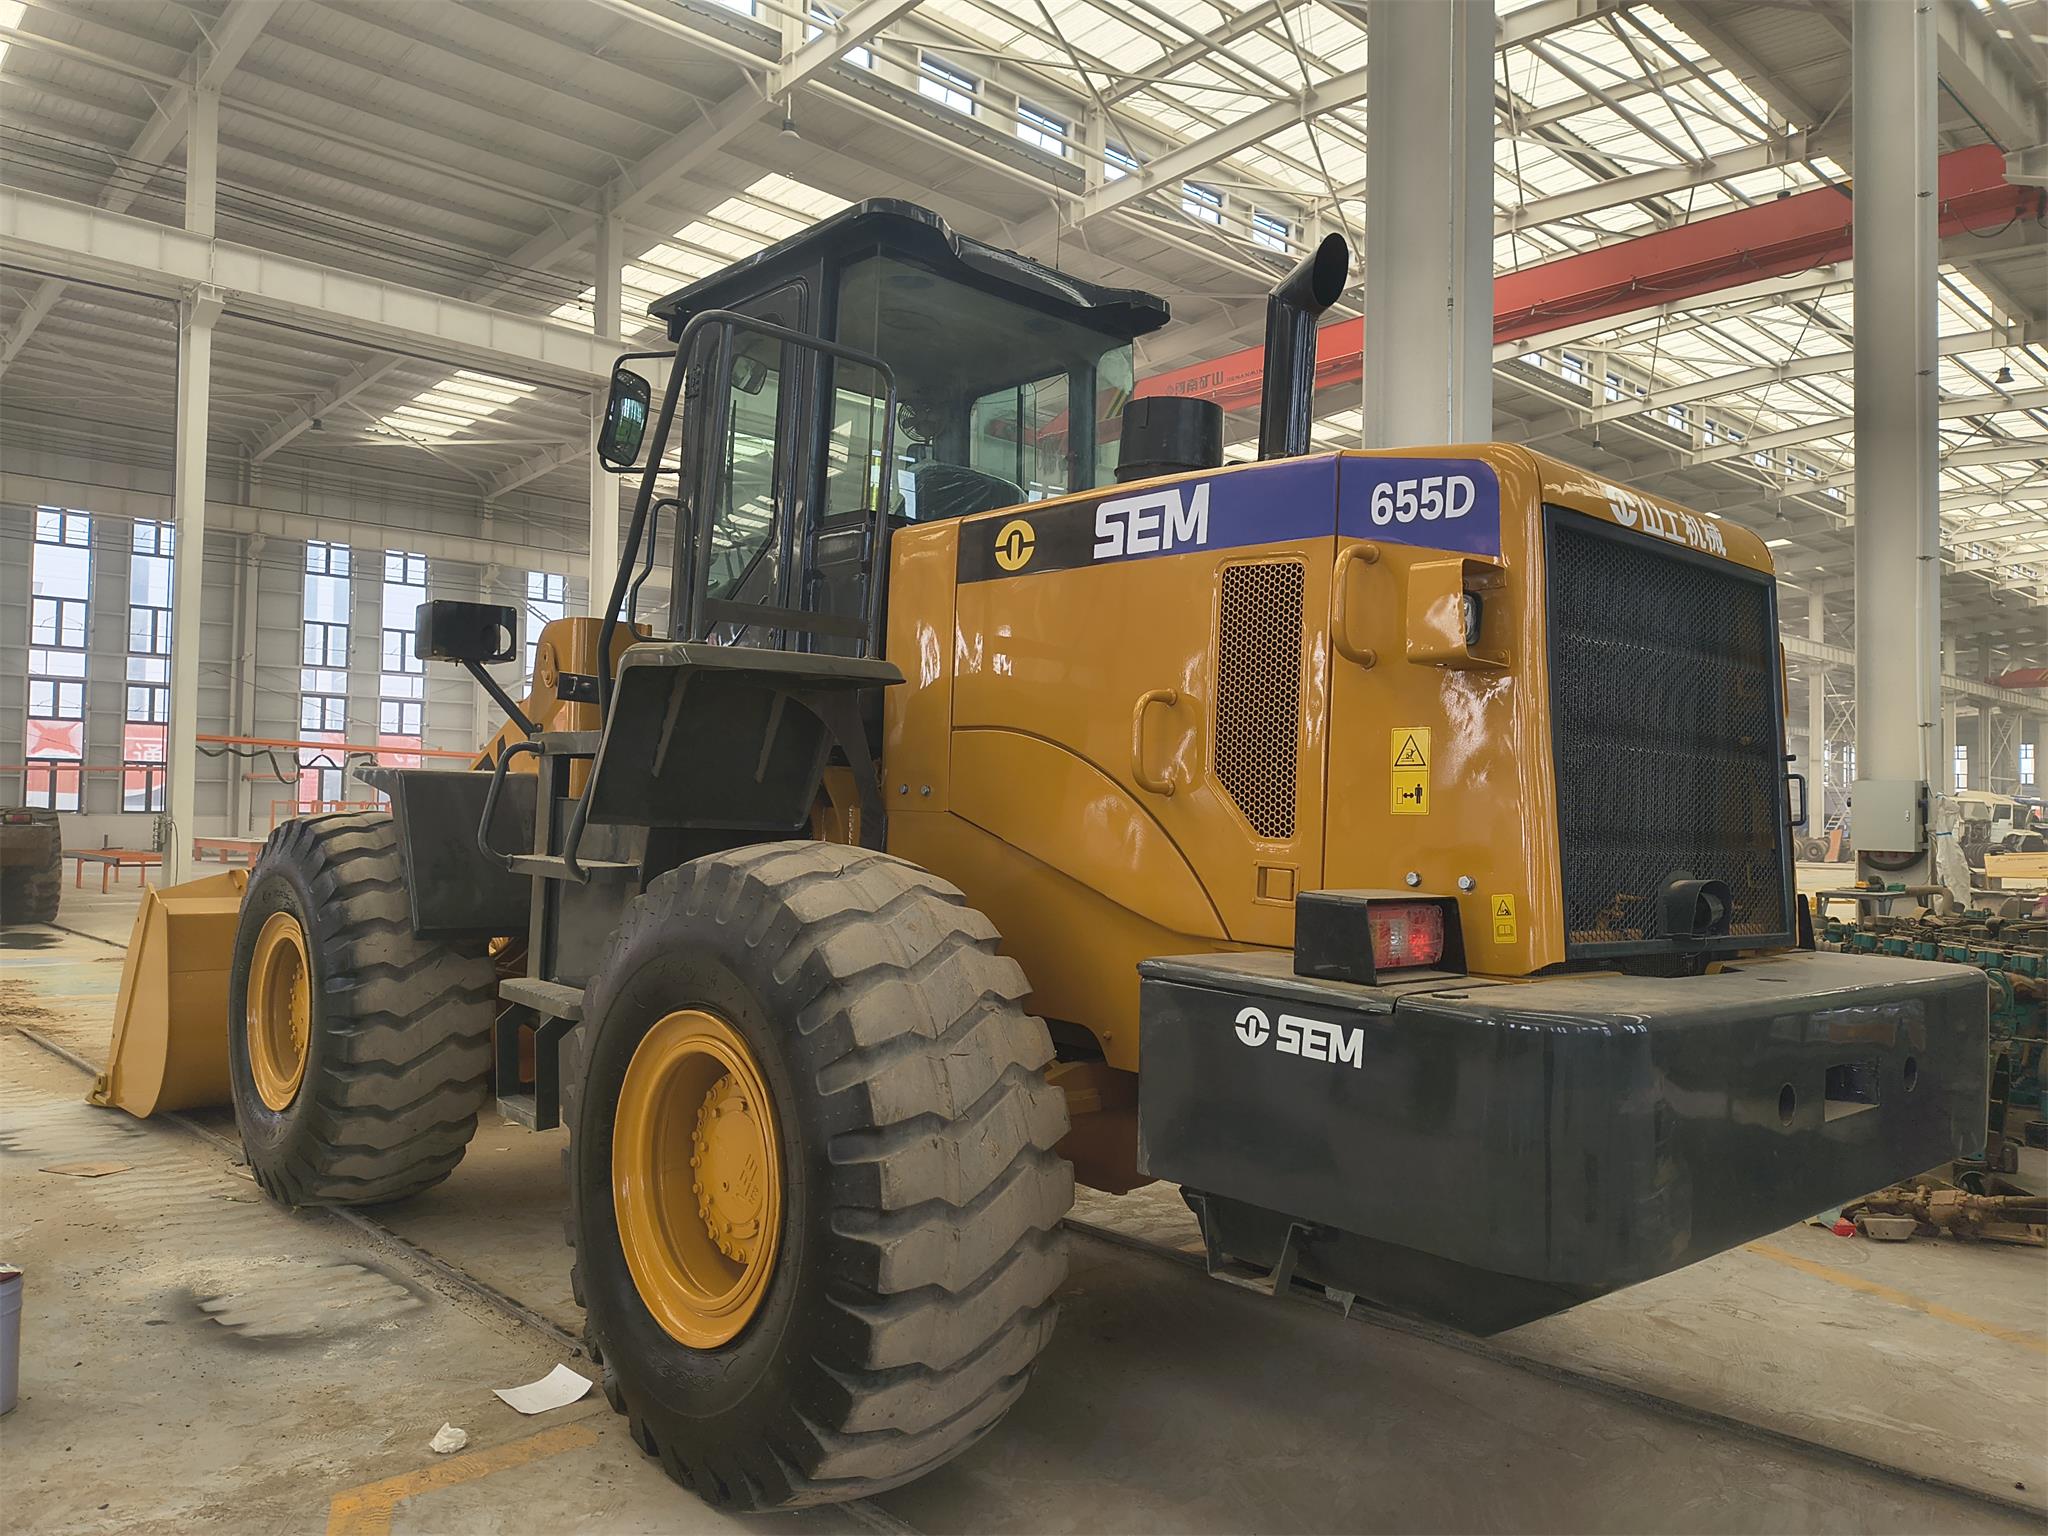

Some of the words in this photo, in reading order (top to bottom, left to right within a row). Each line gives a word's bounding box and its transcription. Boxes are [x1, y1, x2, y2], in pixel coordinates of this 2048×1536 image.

[1093, 482, 1210, 559] SEM
[1371, 475, 1476, 526] 655D
[1636, 497, 1727, 557] 山工机械
[1275, 1013, 1365, 1069] SEM
